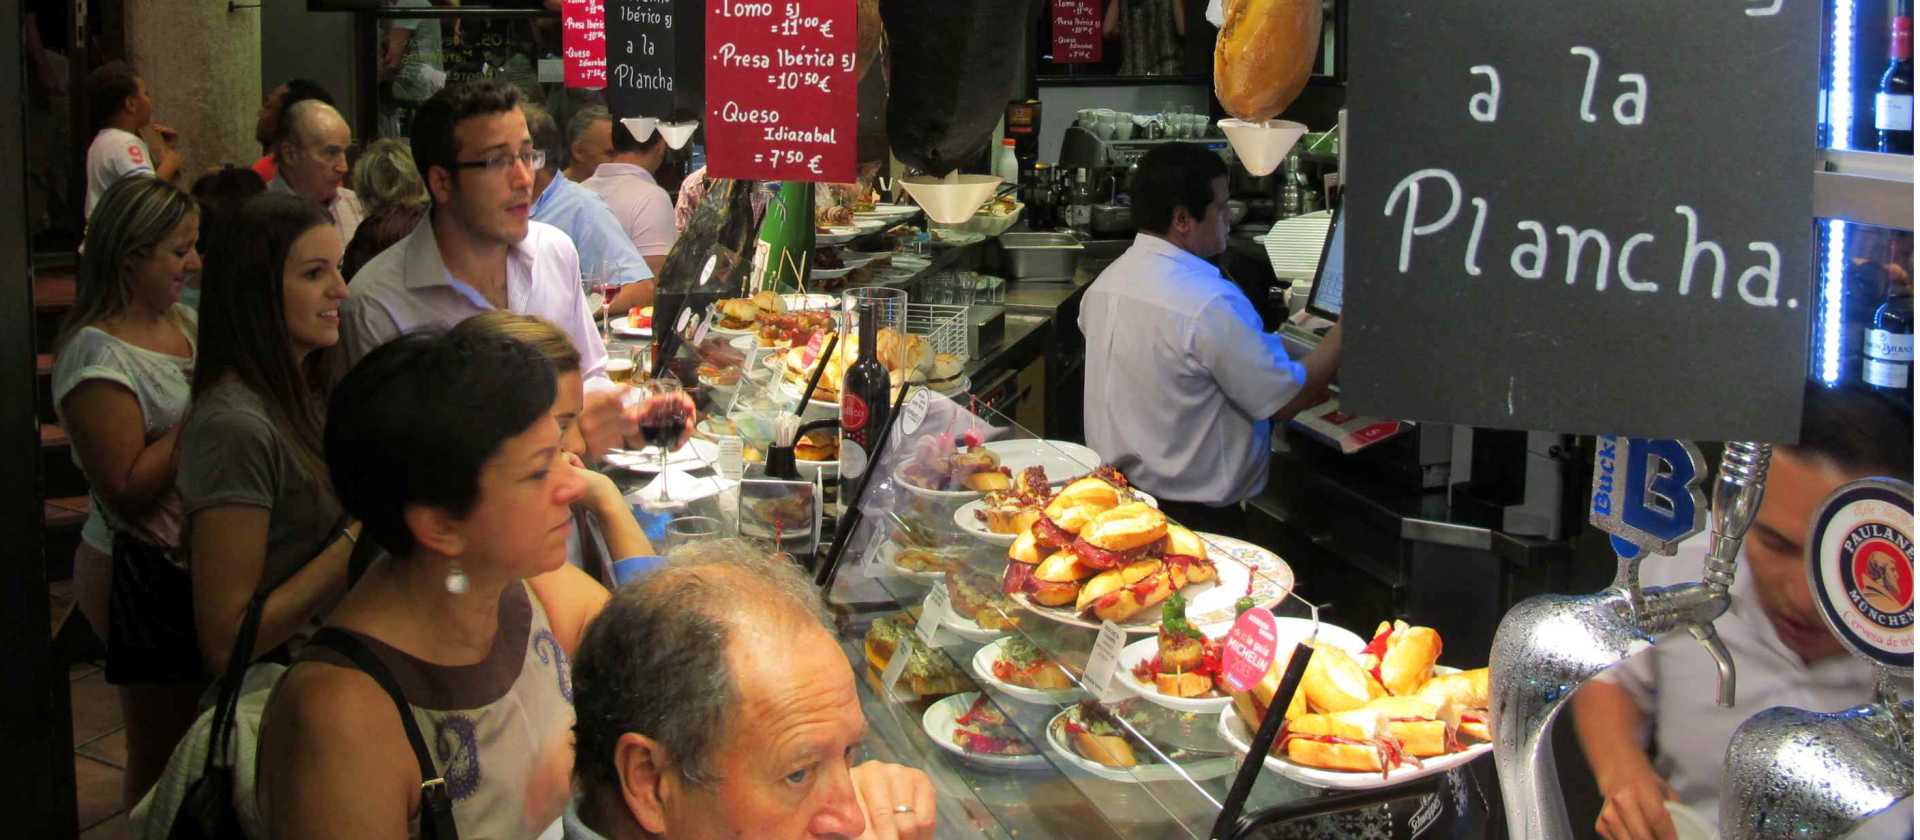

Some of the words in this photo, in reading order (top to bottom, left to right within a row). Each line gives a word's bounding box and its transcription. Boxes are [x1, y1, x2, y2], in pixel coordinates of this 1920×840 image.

[620, 5, 661, 24] Ibérico
[626, 40, 633, 54] a
[641, 33, 655, 56] la
[719, 43, 770, 68] Presa
[777, 45, 834, 67] Ibérica
[613, 63, 673, 92] Plancha
[1468, 65, 1500, 123] a
[1570, 46, 1648, 126] la
[722, 101, 780, 124] Queso
[763, 126, 837, 145] Idiazabal
